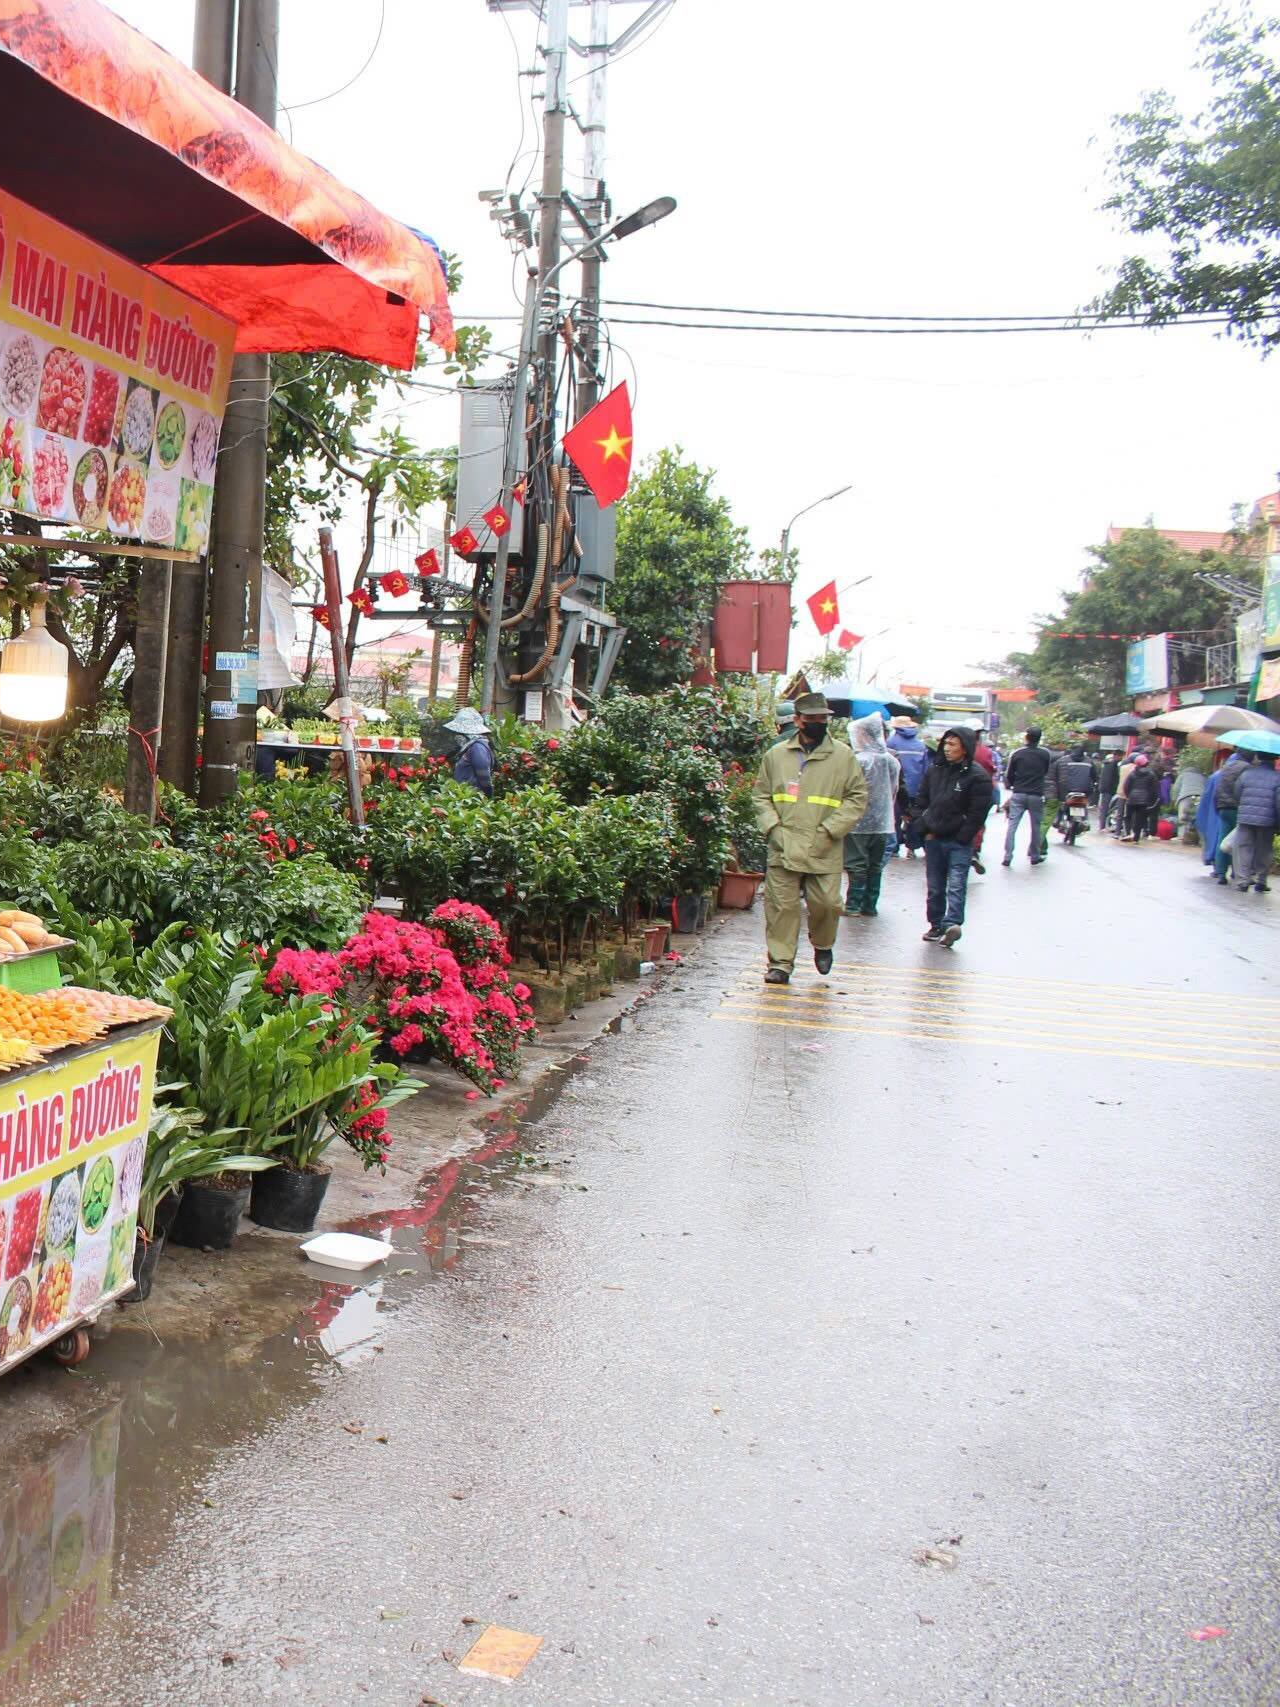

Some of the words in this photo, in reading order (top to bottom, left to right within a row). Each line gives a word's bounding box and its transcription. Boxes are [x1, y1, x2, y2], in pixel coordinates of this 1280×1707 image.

[12, 241, 67, 327] MAI
[72, 272, 143, 361] HÀNG
[144, 315, 217, 395] ĐƯỜNG
[69, 1060, 141, 1151] ĐƯỜNG
